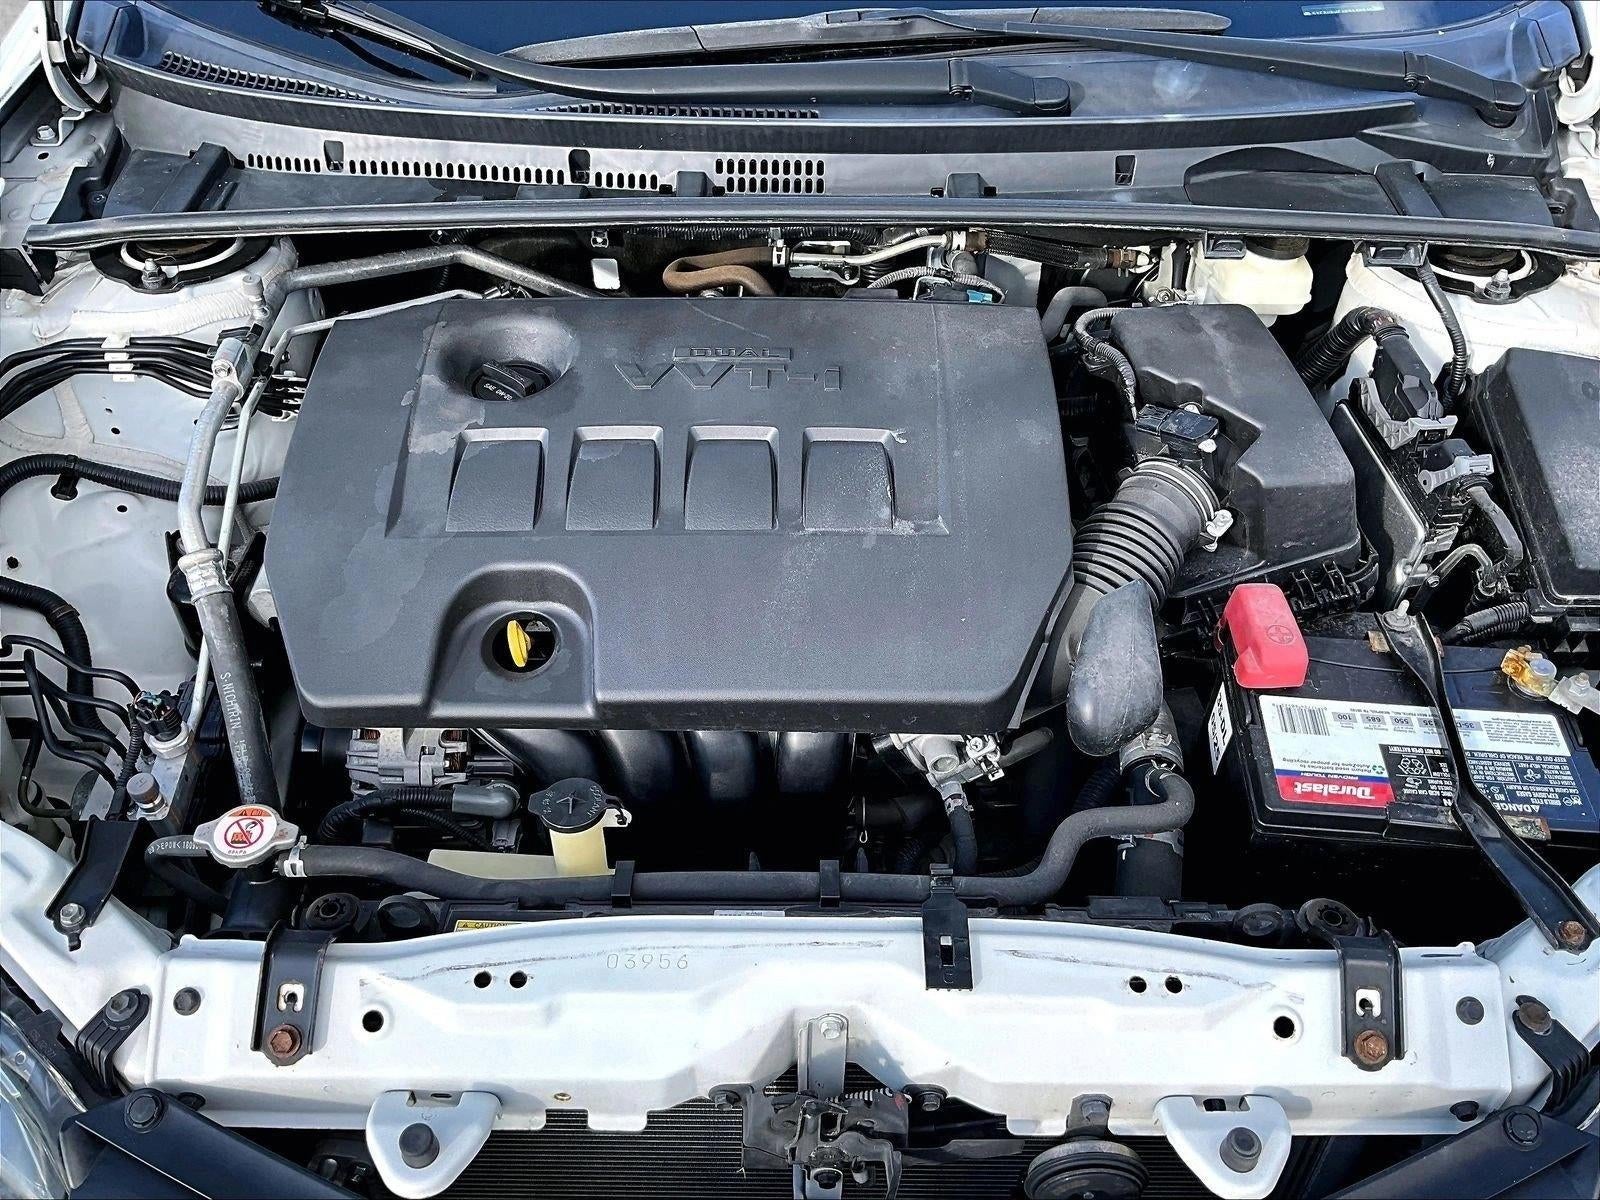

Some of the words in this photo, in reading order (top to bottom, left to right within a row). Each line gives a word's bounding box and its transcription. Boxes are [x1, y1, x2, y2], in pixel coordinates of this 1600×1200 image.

[690, 347, 780, 357] DUAL
[483, 383, 497, 391] SAE
[1455, 721, 1475, 729] 35-D
[1282, 757, 1309, 765] recycling
[1294, 782, 1375, 799] Duralast
[1492, 802, 1531, 812] DANGE
[606, 953, 689, 970] 03956
